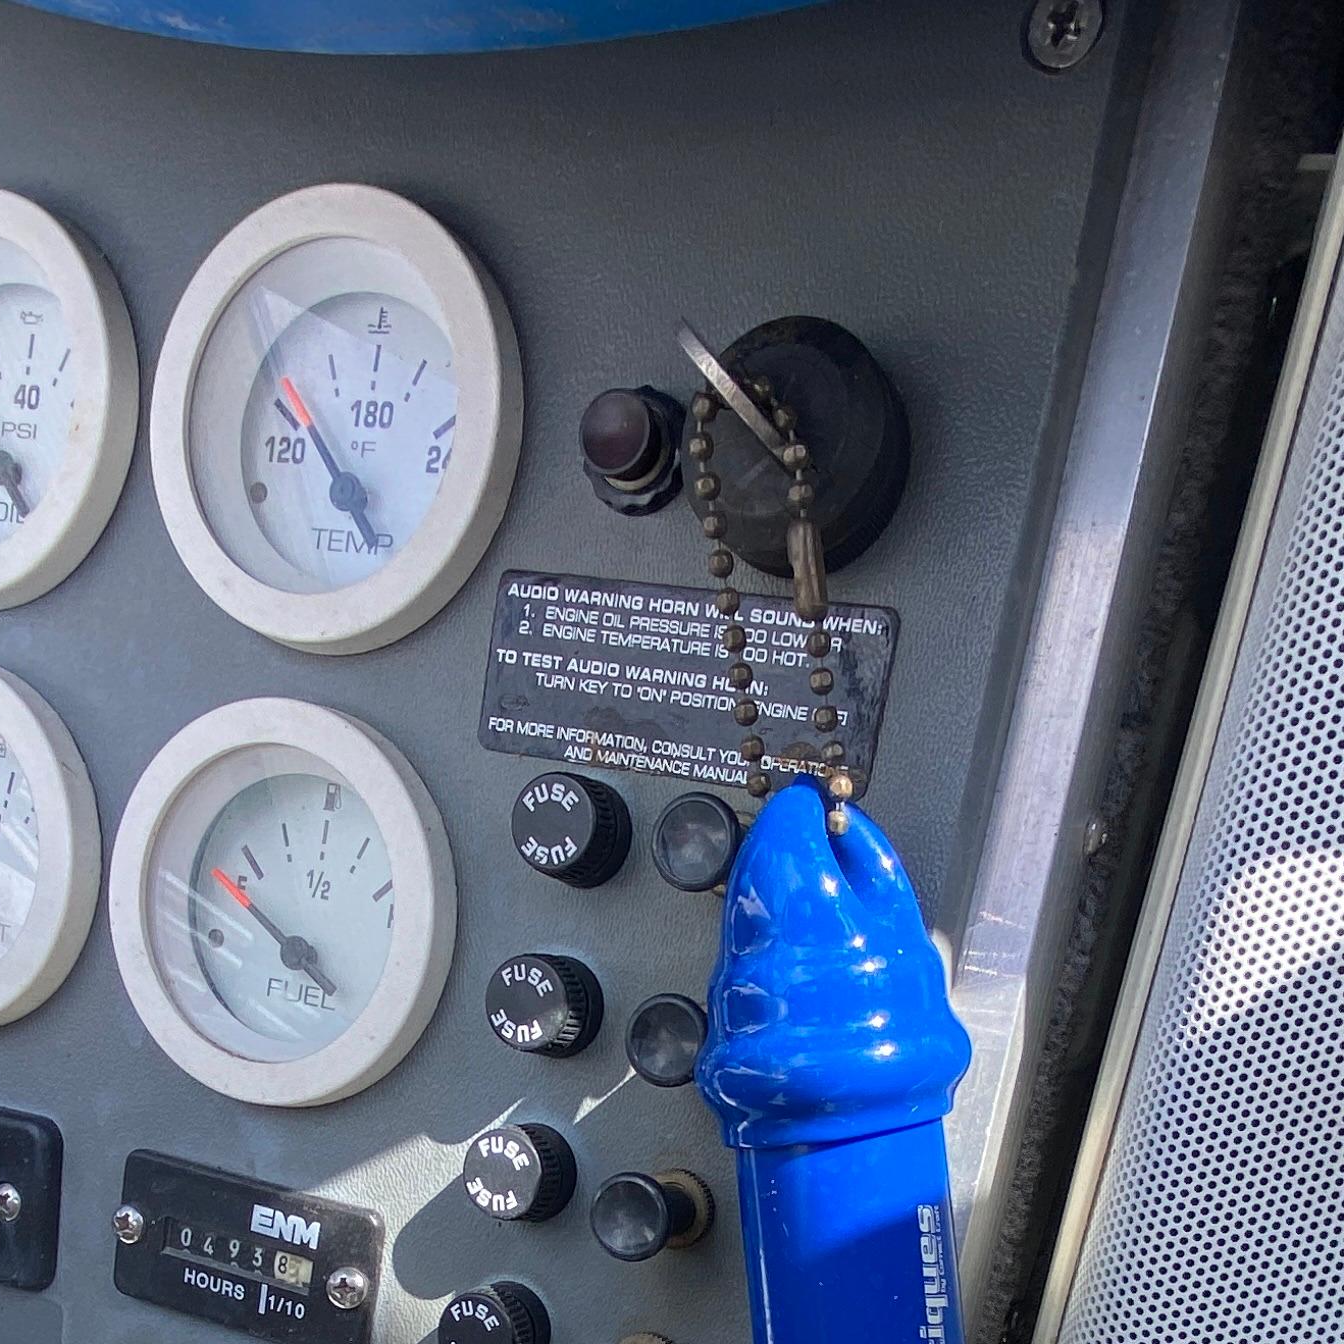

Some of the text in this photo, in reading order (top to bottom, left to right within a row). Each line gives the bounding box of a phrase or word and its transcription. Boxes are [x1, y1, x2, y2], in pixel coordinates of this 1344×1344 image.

[13, 384, 41, 410] 40
[0, 420, 38, 441] PSI
[350, 399, 395, 429] 180
[264, 435, 306, 465] 120
[311, 527, 395, 556] TEMP
[507, 583, 559, 601] AUDIO
[564, 588, 643, 611] WARNING
[648, 598, 700, 617] HORN
[822, 616, 883, 636] WHEN:
[523, 603, 536, 619] 1.
[544, 605, 599, 626] ENGINE
[602, 612, 625, 629] OIL
[629, 616, 710, 638] PRESSURE
[771, 632, 808, 649] LOW
[518, 620, 533, 636] 2.
[542, 623, 596, 643] ENGINE
[600, 630, 710, 657] TEMPERATURE
[714, 642, 729, 658] IS
[772, 651, 810, 668] HOT.
[496, 648, 517, 665] TO
[522, 652, 563, 670] TEST
[566, 658, 620, 677] AUDIO
[625, 665, 707, 689] WARNING
[535, 672, 576, 691] TURN
[578, 679, 609, 695] KEY
[612, 682, 632, 699] TO
[488, 717, 514, 733] FOR
[516, 721, 554, 738] MORE
[556, 727, 648, 753] INFORMATION,
[651, 740, 716, 762] CONSULT
[564, 745, 592, 762] AND
[595, 750, 690, 776] MAINTENANCE
[523, 783, 580, 813] FUSE
[518, 835, 579, 867] FUSE
[306, 868, 331, 901] 1/2
[266, 977, 337, 1012] FUEL
[501, 962, 554, 998] FUSE
[491, 1008, 543, 1044] FUSE
[477, 1136, 531, 1172] FUSE
[466, 1177, 518, 1212] FUSE
[250, 1203, 321, 1251] ENM
[183, 1267, 246, 1301] HOURS
[268, 1294, 306, 1320] 1/10
[451, 1301, 501, 1333] FUSE
